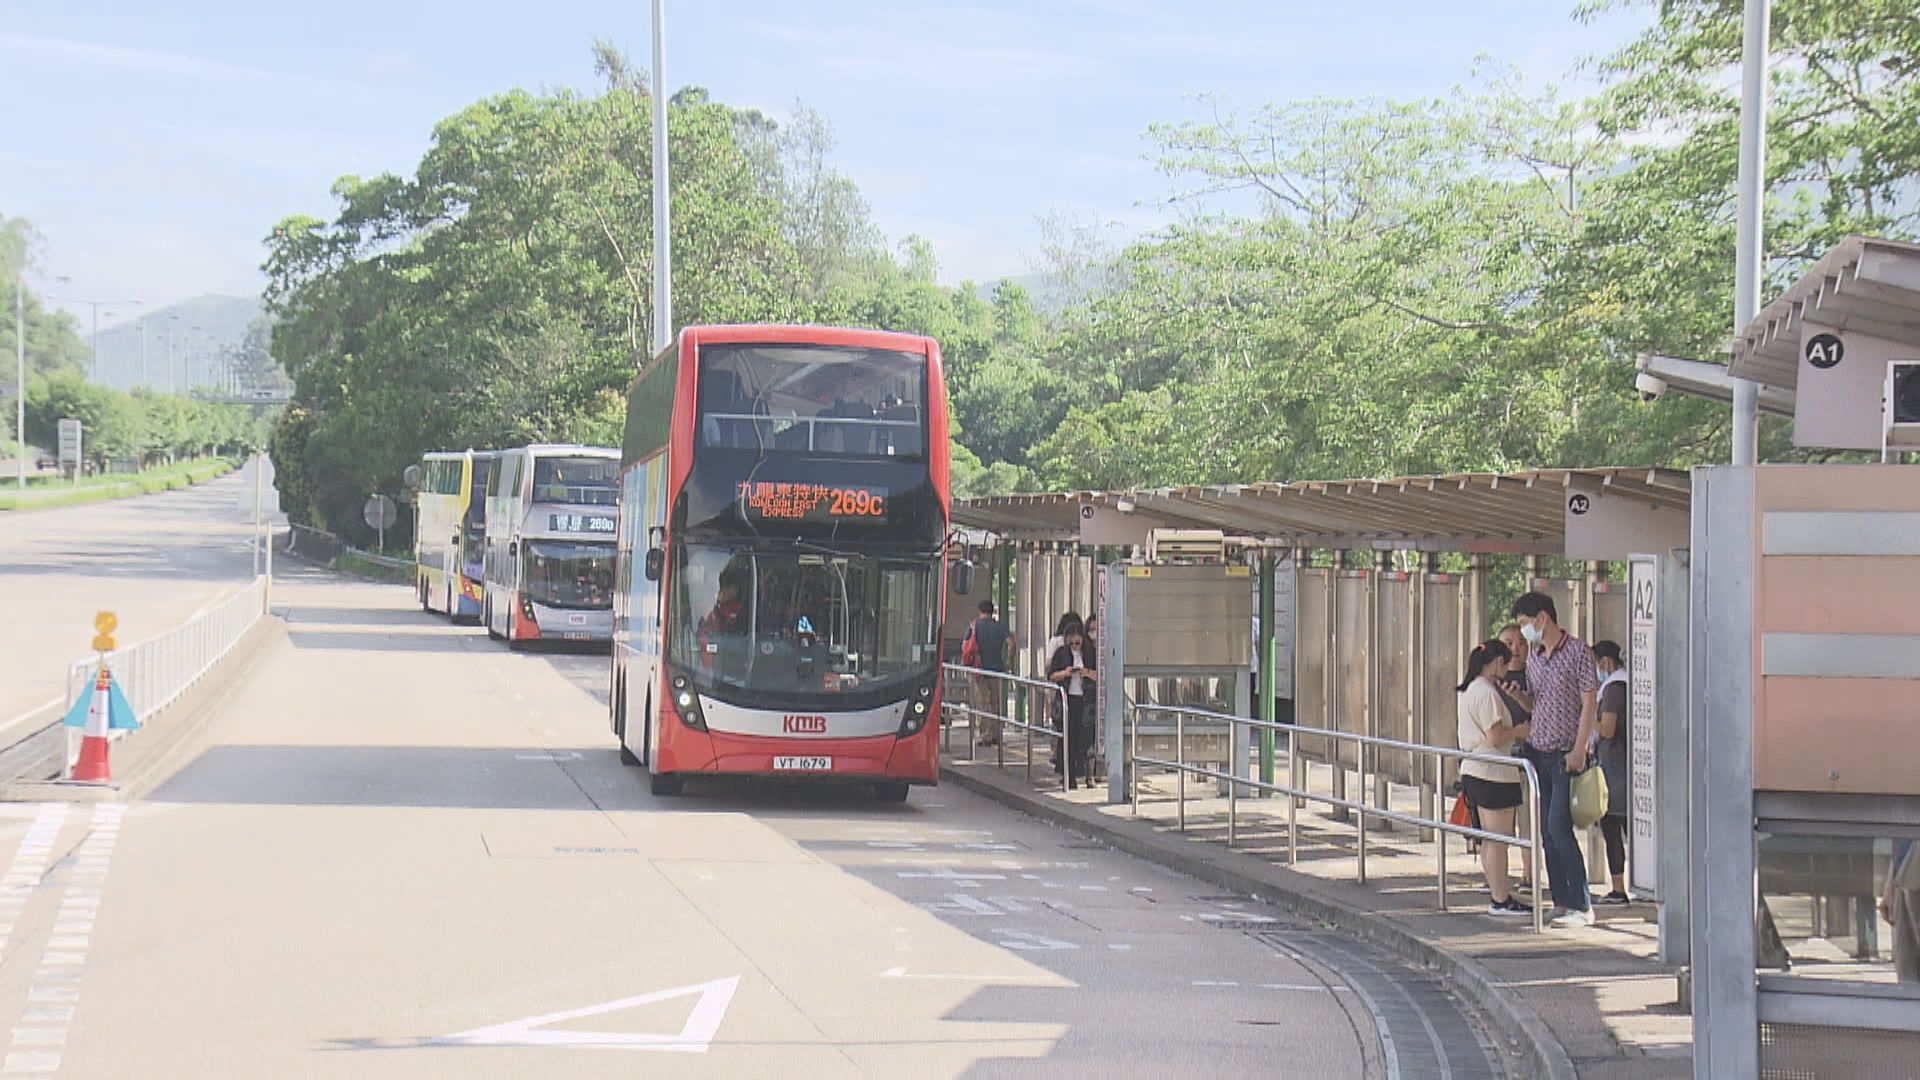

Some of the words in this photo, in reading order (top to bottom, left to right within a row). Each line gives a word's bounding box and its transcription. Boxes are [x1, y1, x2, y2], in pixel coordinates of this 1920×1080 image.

[1808, 342, 1838, 362] A1
[738, 481, 829, 501] 九龍東特快
[1570, 499, 1588, 511] A2
[1634, 579, 1654, 620] A2
[783, 715, 827, 733] KMB
[779, 757, 794, 769] VT
[799, 757, 827, 769] 1679
[1635, 817, 1652, 838] T270
